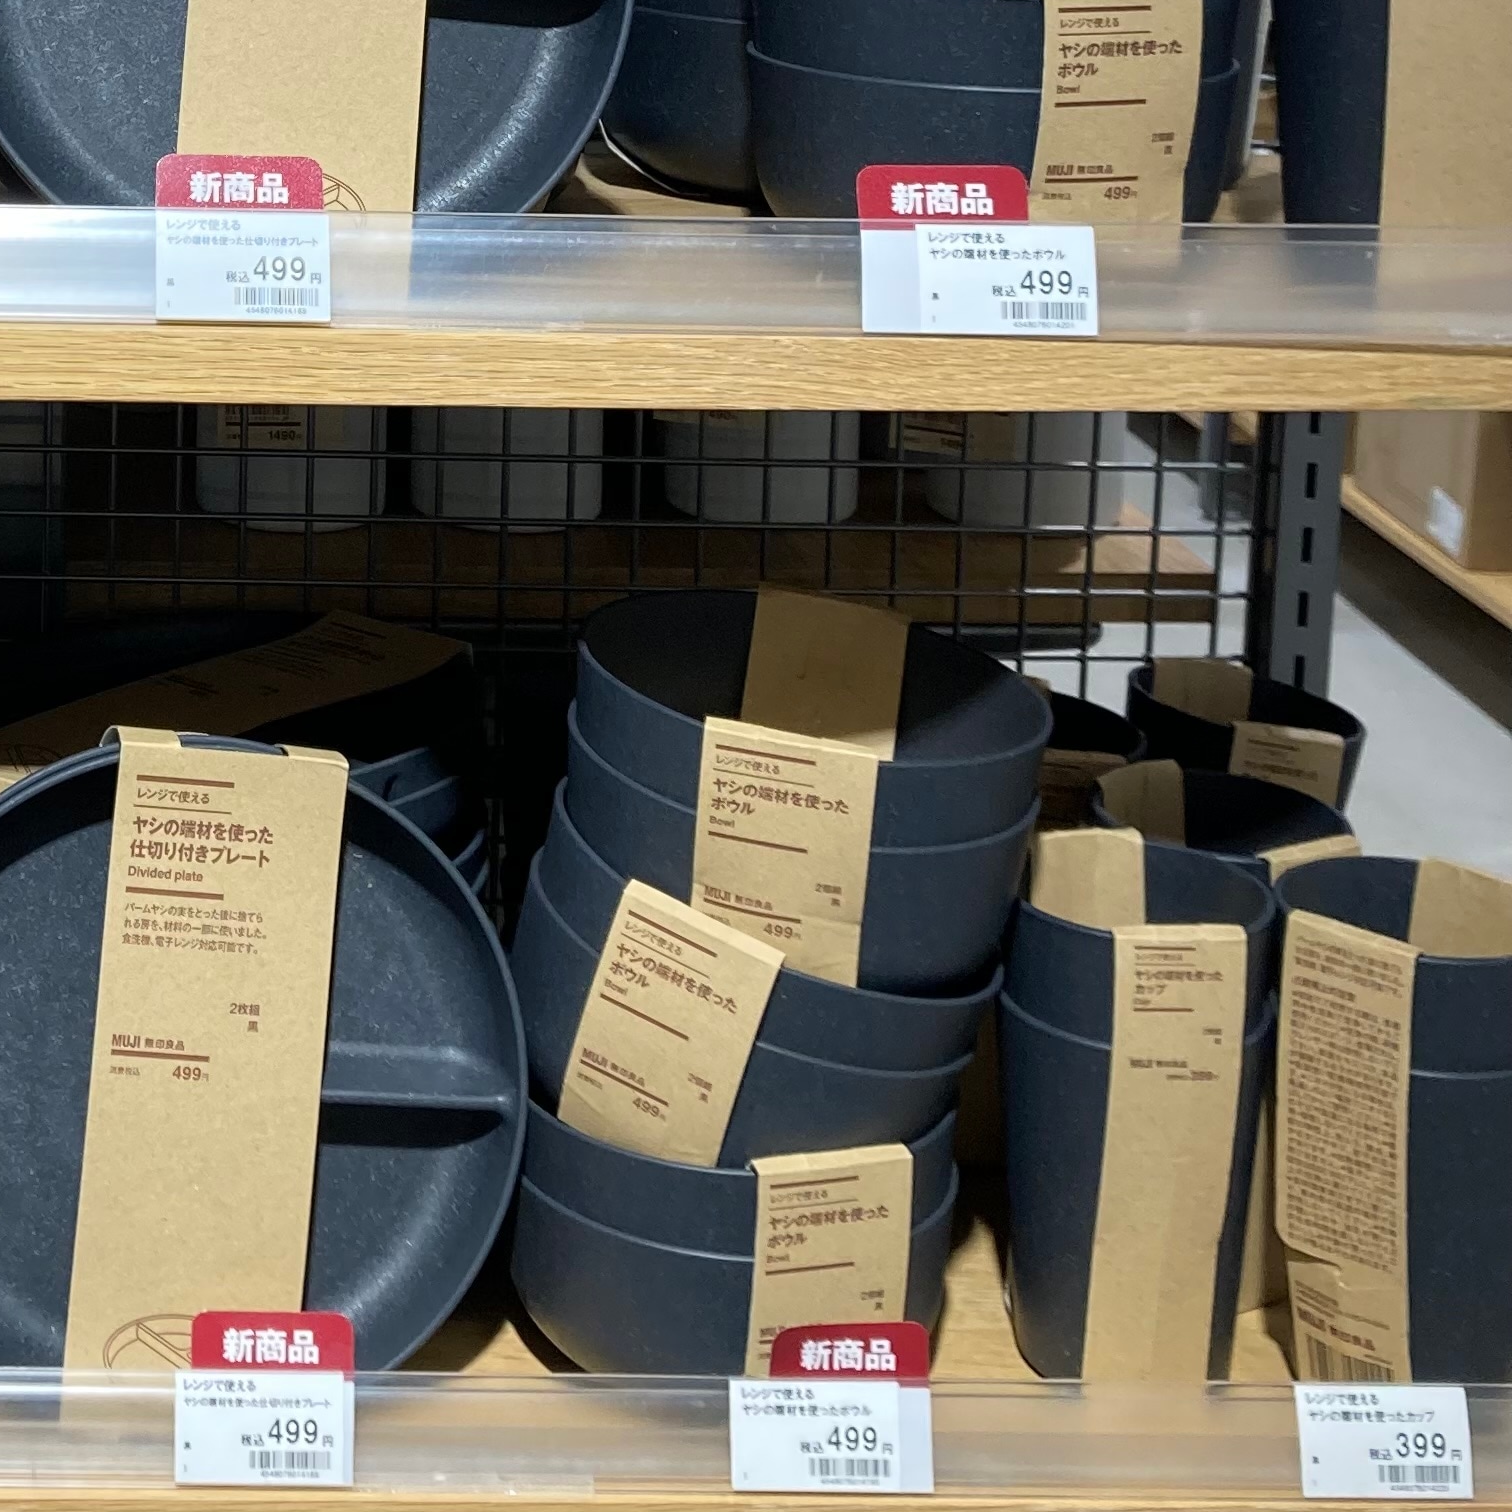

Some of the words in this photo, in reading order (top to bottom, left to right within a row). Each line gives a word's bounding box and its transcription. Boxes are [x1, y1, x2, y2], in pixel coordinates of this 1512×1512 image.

[1059, 40, 1182, 58] ヤシの端材を使った
[1058, 63, 1098, 78] ボウル
[190, 172, 289, 204] 新商品
[891, 182, 994, 215] 新商品
[166, 219, 241, 231] レンジで使える
[928, 233, 1005, 244] レンジで使える
[929, 248, 1065, 260] ヤシの端材を使ったボウル
[226, 271, 250, 283] 税込
[992, 285, 1016, 297] 税込
[716, 755, 780, 775] レンジで使える
[137, 788, 210, 805] レンジで使える
[713, 778, 849, 814] ヤシの端材を使った
[711, 797, 755, 815] ボウル
[709, 815, 735, 828] Bowl
[133, 817, 273, 845] ヤシの端材を使った
[130, 840, 270, 867] 仕切り付きプレート
[128, 866, 172, 880] Divided
[174, 870, 203, 883] plate
[704, 885, 730, 902] MUJI
[609, 961, 650, 988] ボウル
[617, 943, 737, 1014] ヤシの端材を使った
[230, 1004, 260, 1016] 2枚組
[112, 1034, 141, 1049] MUJI
[222, 1328, 319, 1364] 新商品
[800, 1338, 896, 1372] 新商品
[184, 1379, 256, 1392] レンジで使える
[741, 1388, 815, 1400] レンジで使える
[1305, 1394, 1379, 1406] レンジで使える
[241, 1434, 264, 1446] 税込
